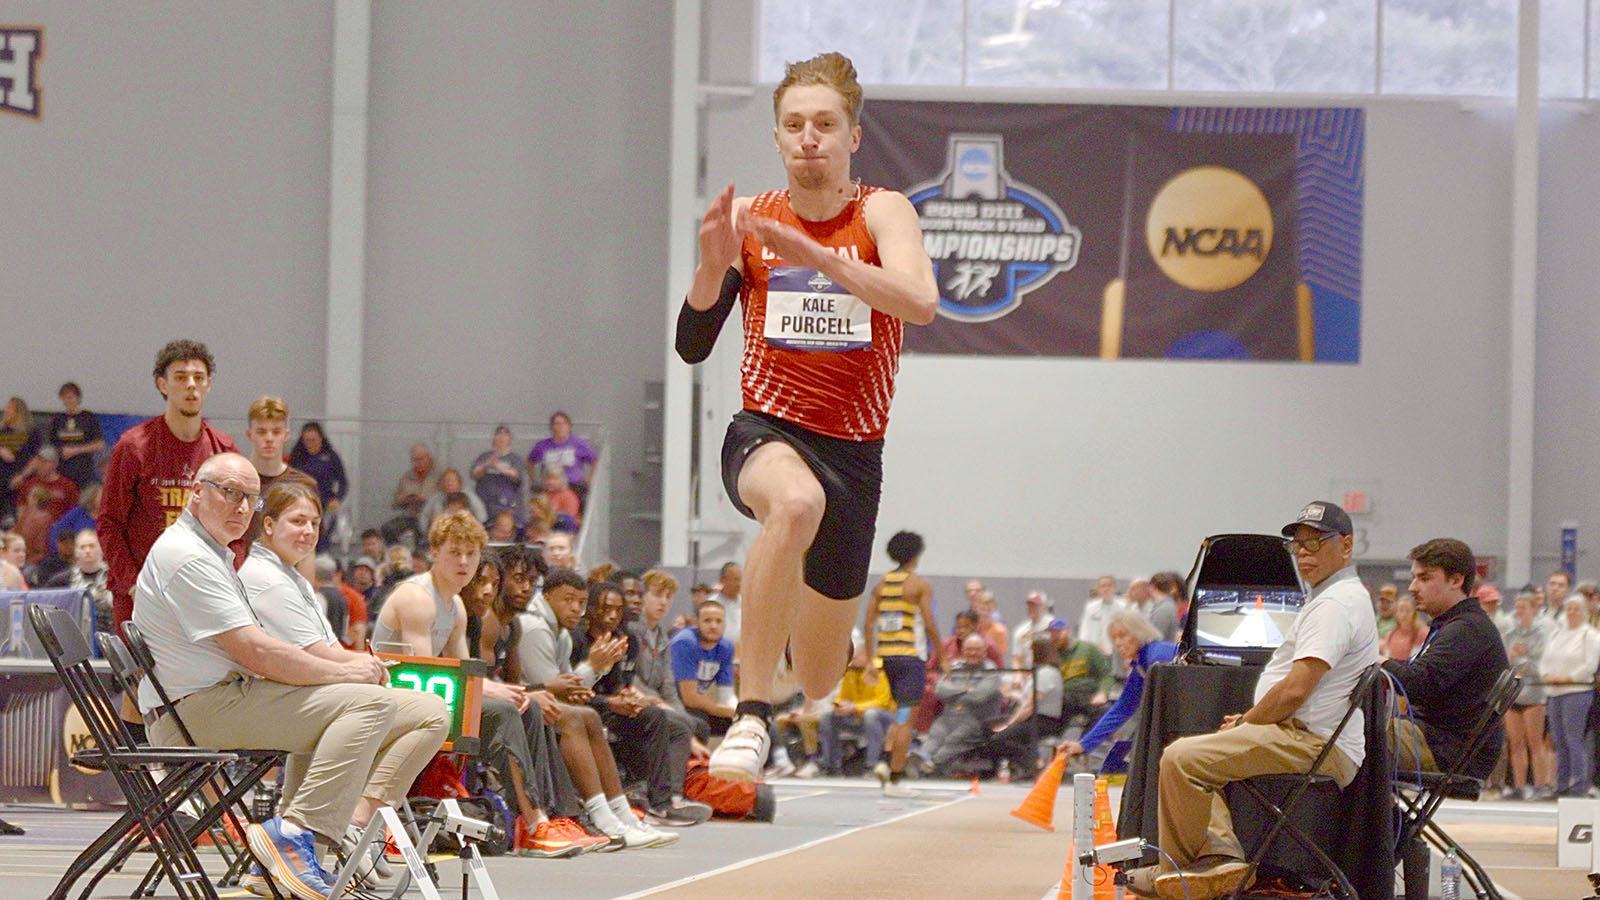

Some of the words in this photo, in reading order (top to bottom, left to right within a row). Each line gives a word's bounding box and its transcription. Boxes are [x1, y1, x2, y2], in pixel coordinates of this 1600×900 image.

[922, 232, 1074, 261] MPIONSHIPS
[1162, 227, 1264, 258] NCAA
[802, 298, 834, 313] KALE
[781, 316, 854, 335] PURCELL
